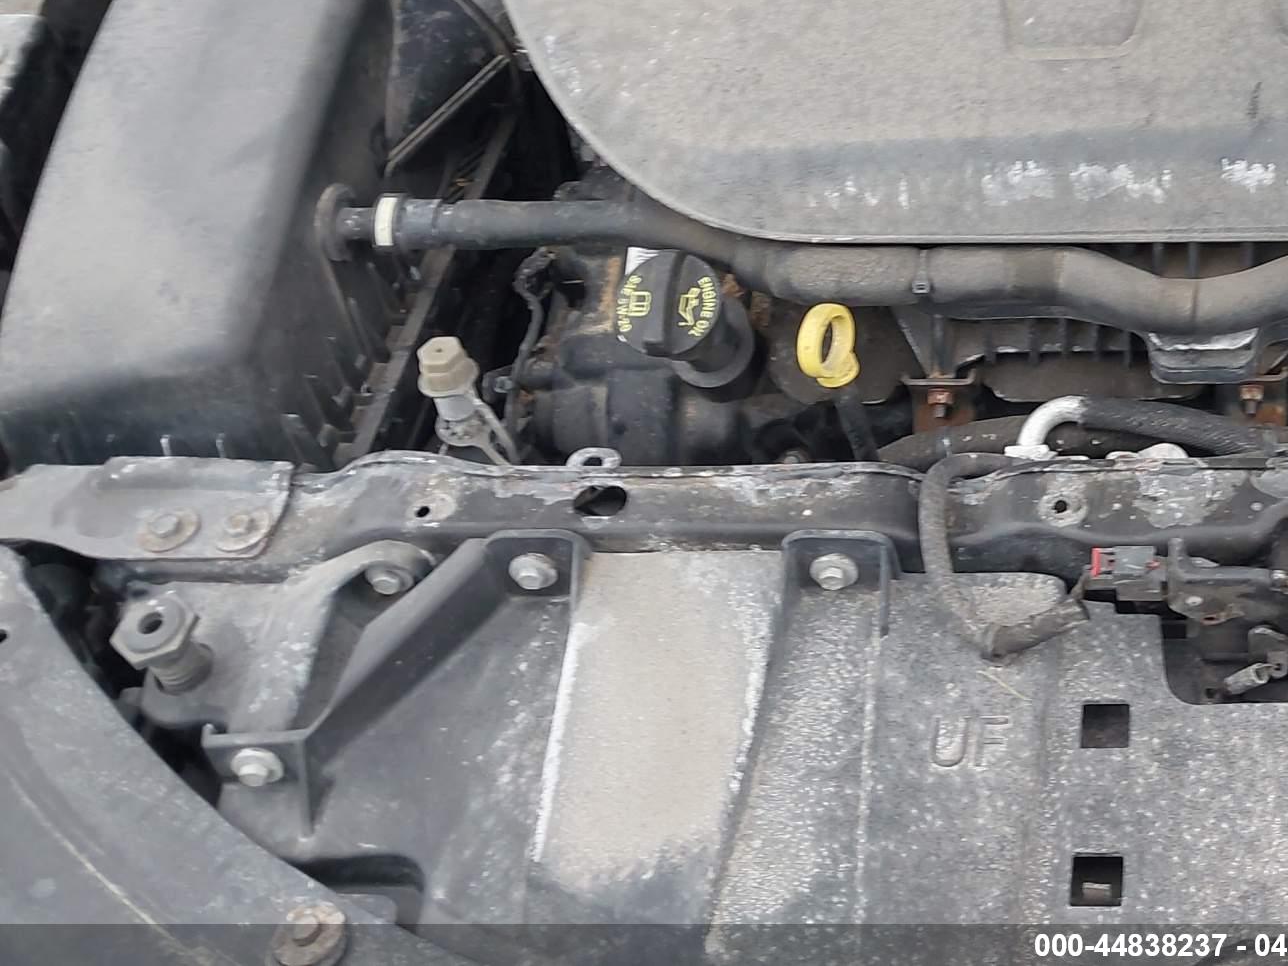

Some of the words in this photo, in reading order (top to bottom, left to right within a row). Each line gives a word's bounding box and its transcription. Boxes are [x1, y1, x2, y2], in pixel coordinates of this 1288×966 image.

[697, 276, 717, 319] ENGINE
[687, 319, 710, 337] OIL
[928, 715, 1010, 770] UF
